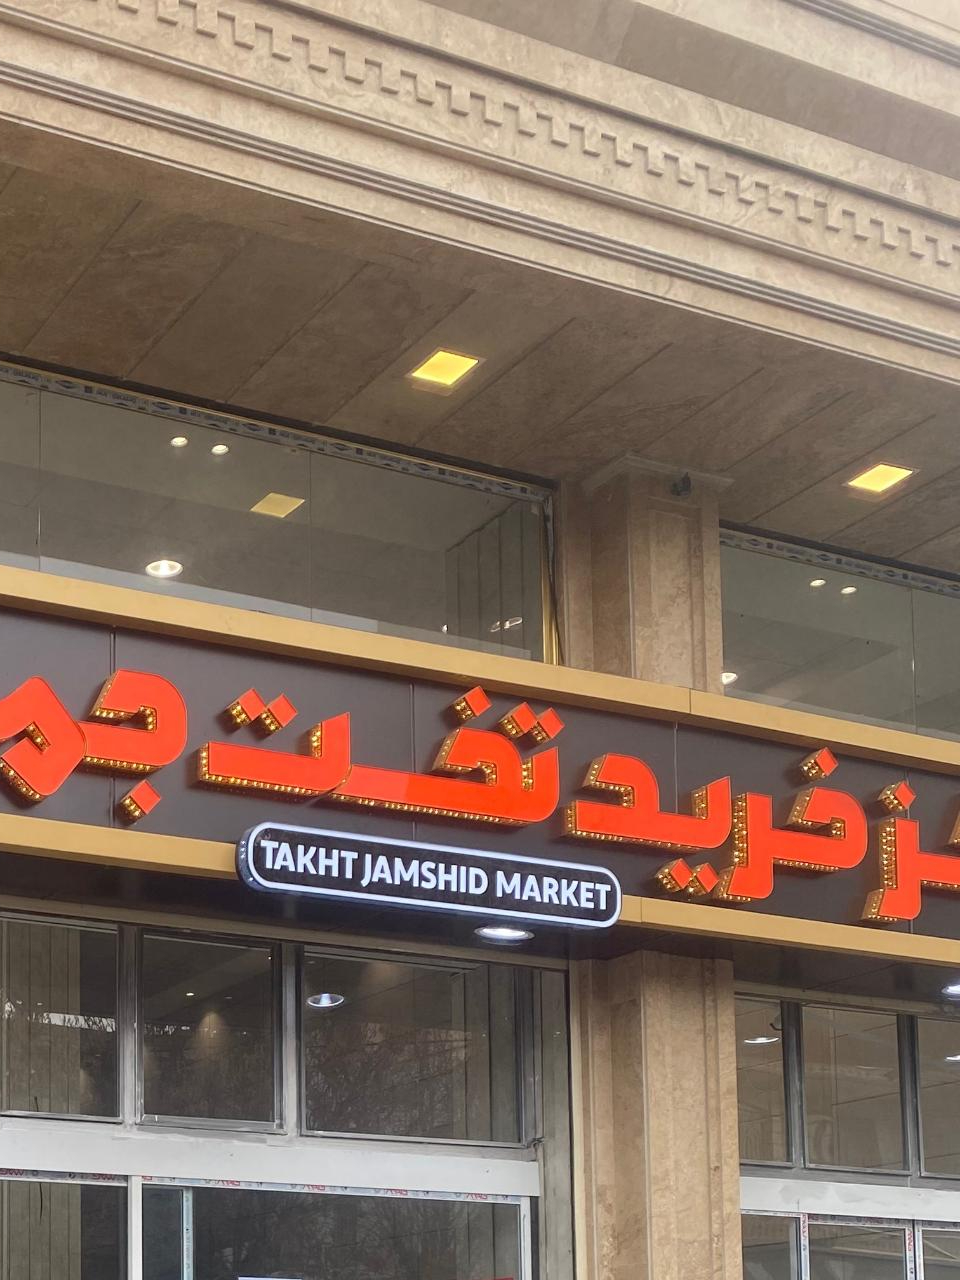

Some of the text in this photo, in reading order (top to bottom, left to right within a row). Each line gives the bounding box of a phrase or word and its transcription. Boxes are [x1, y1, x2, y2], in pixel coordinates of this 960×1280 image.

[198, 684, 561, 827] تخت
[565, 747, 869, 902] خرید
[260, 839, 612, 911] TAKHT JAMSHID MARKET
